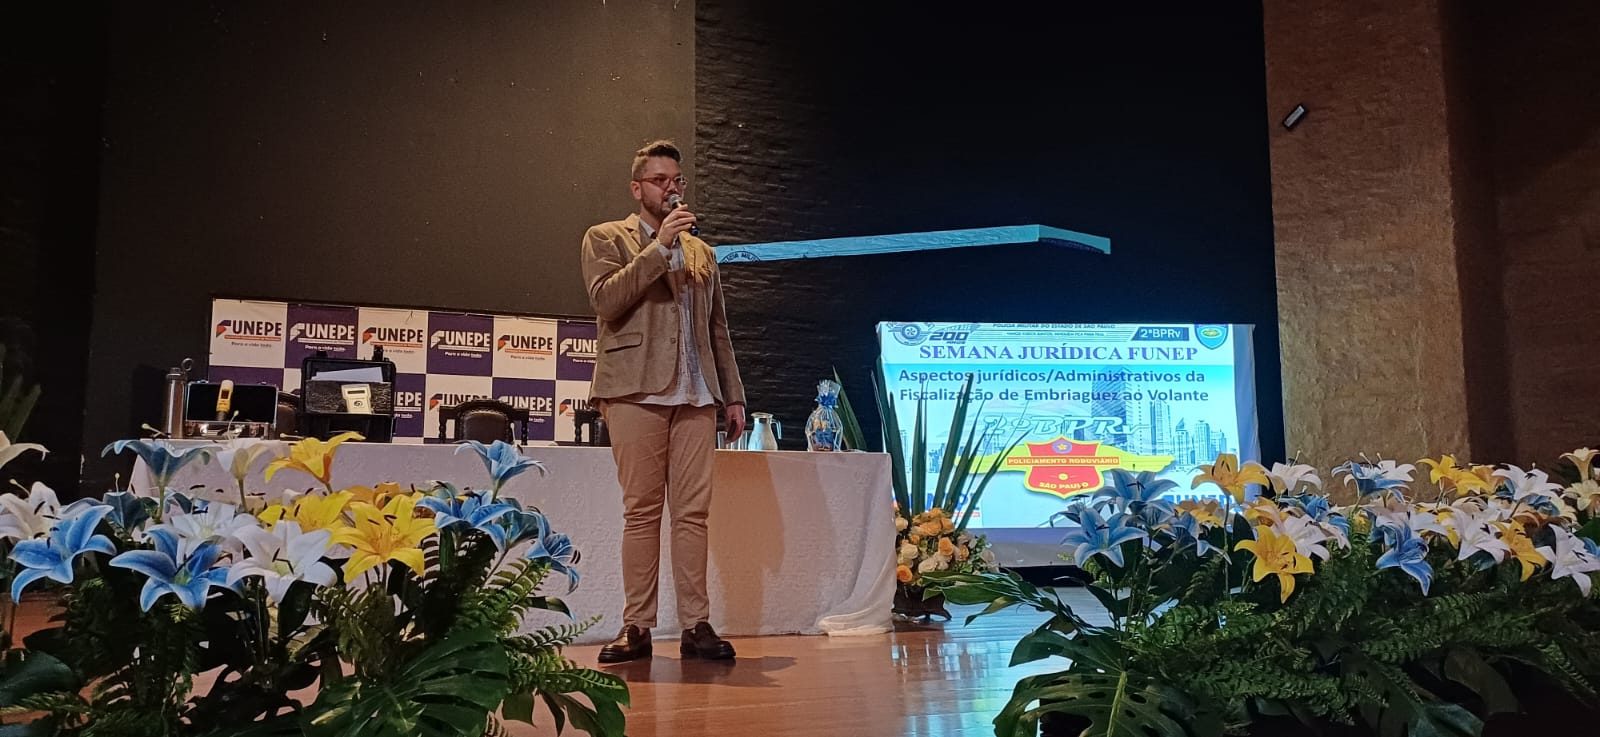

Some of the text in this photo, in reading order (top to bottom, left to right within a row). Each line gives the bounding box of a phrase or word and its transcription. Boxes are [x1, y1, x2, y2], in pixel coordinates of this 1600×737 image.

[929, 331, 970, 341] 200
[560, 338, 598, 356] FUNE
[919, 343, 1198, 361] SEMANA JURÍDICA FUNEP
[898, 368, 1206, 385] Aspectos jurídicos/Administrativos da
[999, 388, 1019, 401] de
[1024, 388, 1119, 404] Embriaguez
[1122, 390, 1144, 402] ao
[1147, 388, 1209, 402] Volante
[1039, 480, 1089, 490] SÃO PAULO
